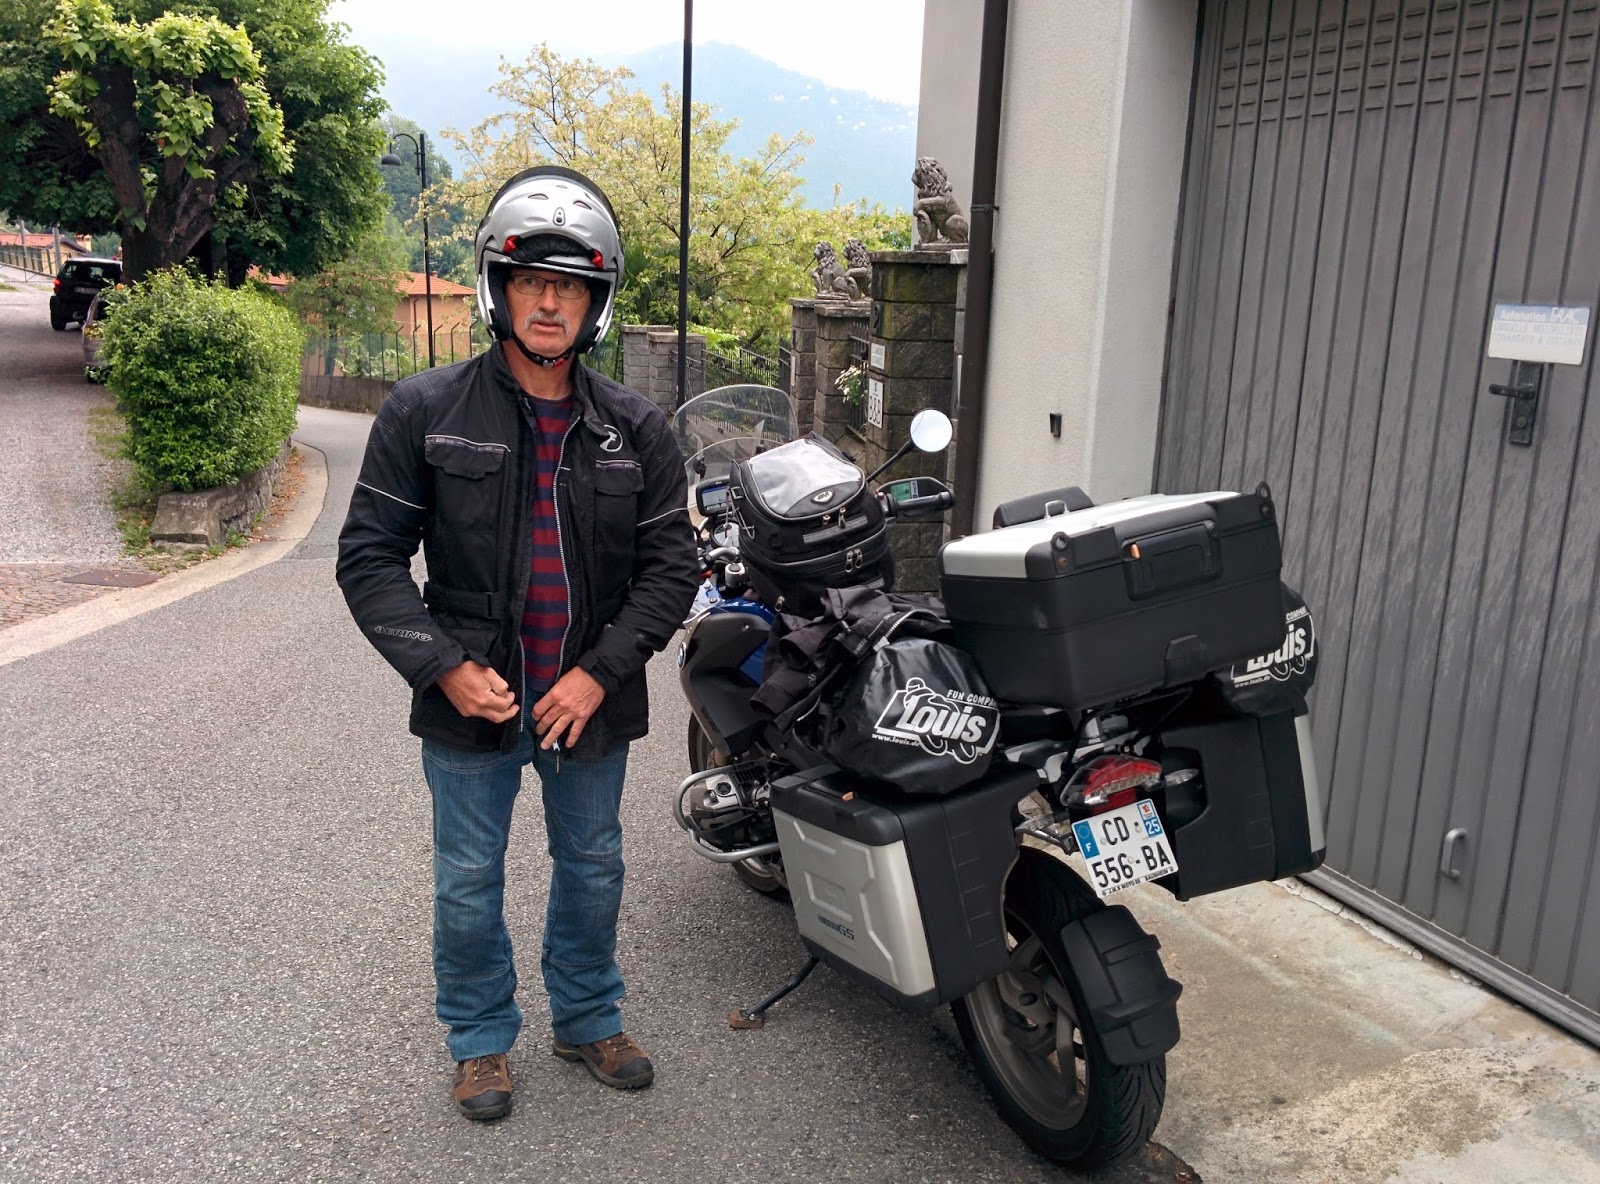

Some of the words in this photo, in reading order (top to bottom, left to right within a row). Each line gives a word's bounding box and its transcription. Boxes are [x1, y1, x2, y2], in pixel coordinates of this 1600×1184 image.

[946, 689, 965, 701] FUN
[895, 695, 987, 743] Louis
[1145, 818, 1161, 835] 25
[1085, 842, 1092, 852] F
